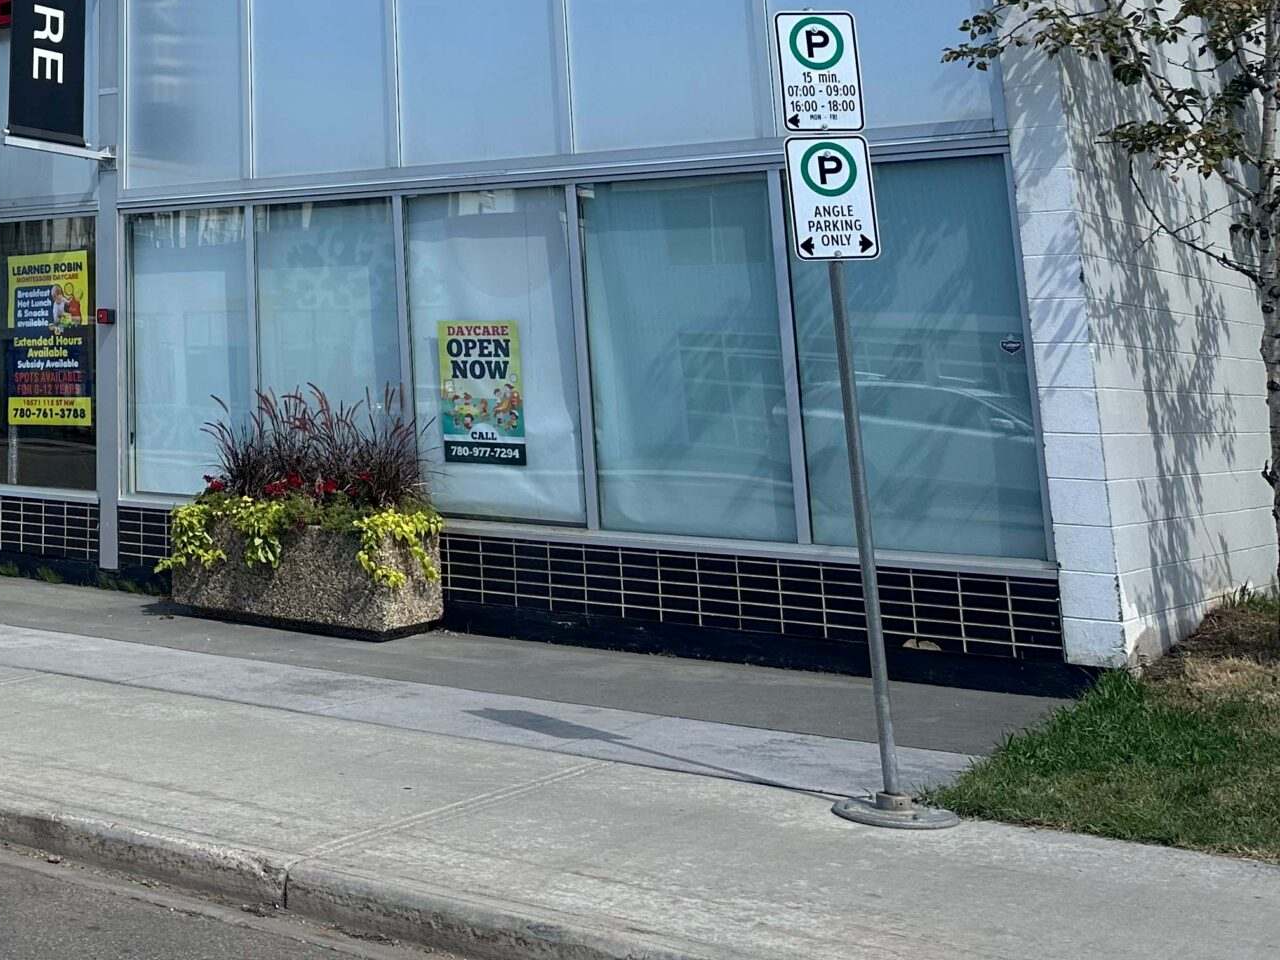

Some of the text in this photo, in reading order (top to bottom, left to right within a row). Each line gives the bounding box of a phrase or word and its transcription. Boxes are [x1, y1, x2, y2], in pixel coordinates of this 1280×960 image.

[802, 71, 841, 84] 15 min.
[787, 85, 816, 97] 07:00
[825, 84, 856, 97] 09:00
[790, 100, 818, 113] 16:00
[827, 100, 856, 112] 18:00
[814, 205, 854, 218] ANGLE
[808, 219, 862, 232] PARKING
[821, 234, 852, 247] ONLY
[12, 261, 83, 276] LEARNED ROBIN
[17, 289, 51, 299] Breakfast
[17, 298, 52, 308] Hot Lunch
[24, 308, 49, 317] Snacks
[17, 318, 49, 327] available
[447, 325, 509, 337] DAYCARE
[14, 335, 83, 347] Extended Hours
[27, 346, 68, 358] Available
[446, 338, 511, 358] OPEN
[17, 358, 79, 371] Subsidy Available
[450, 360, 510, 380] NOW
[15, 372, 40, 383] SPOTS
[13, 408, 86, 419] 780-761-3788
[471, 431, 498, 441] CALL
[450, 446, 520, 459] 780-977-7294
